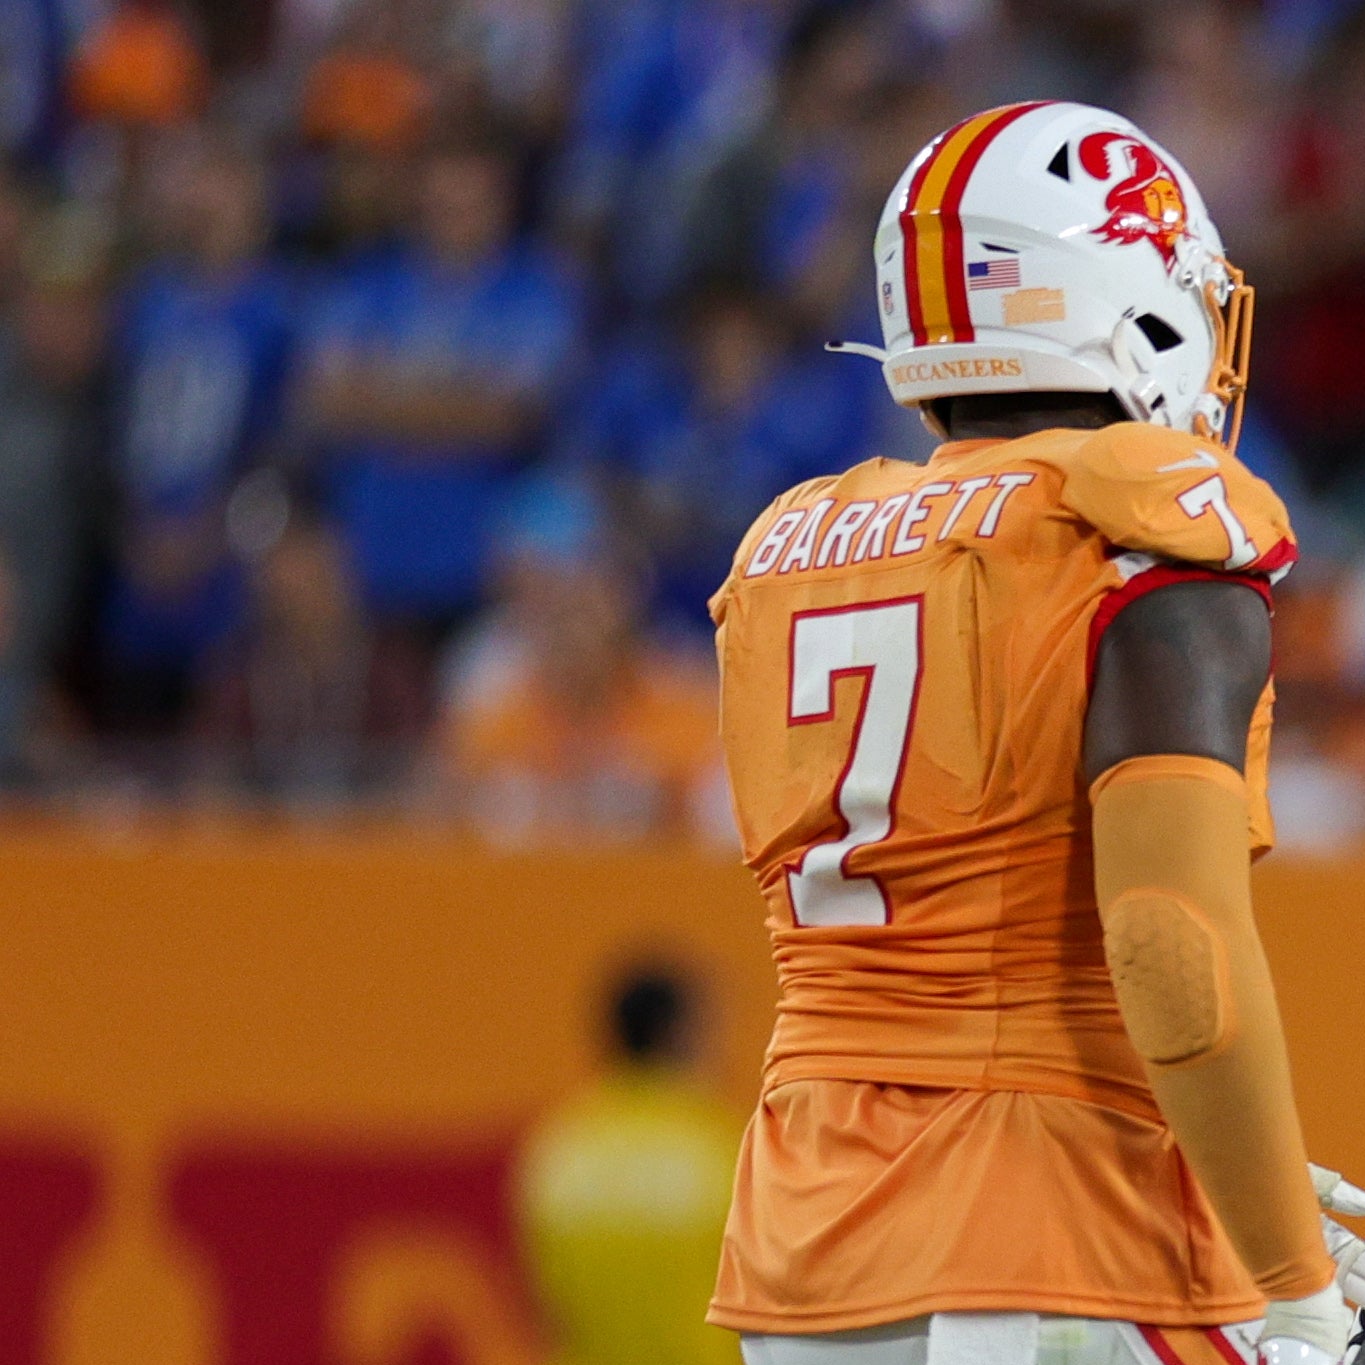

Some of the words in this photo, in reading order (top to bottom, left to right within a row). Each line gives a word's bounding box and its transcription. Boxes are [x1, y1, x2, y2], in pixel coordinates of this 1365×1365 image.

[743, 472, 1037, 579] BARRETT
[1174, 472, 1259, 571] 7
[787, 594, 924, 928] 7
